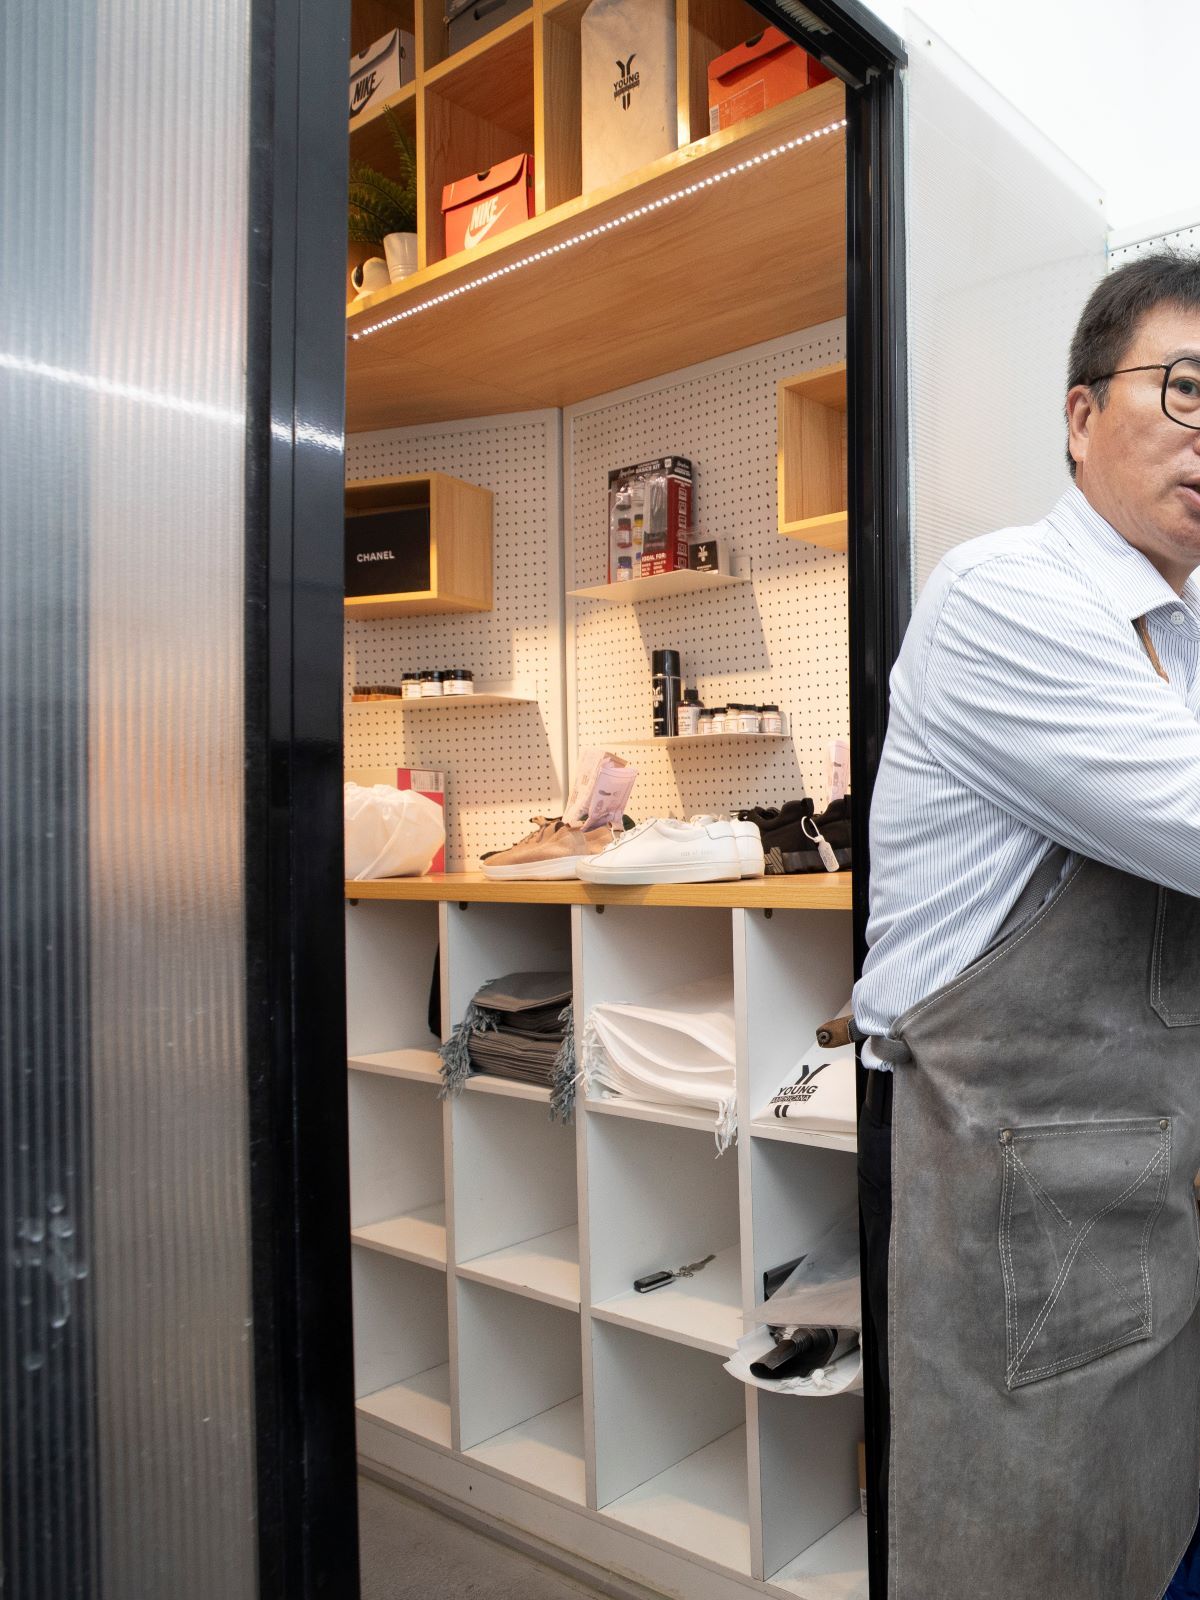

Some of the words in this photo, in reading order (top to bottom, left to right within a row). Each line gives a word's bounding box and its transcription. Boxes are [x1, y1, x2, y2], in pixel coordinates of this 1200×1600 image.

[352, 71, 377, 104] NIKE
[613, 71, 640, 91] YOUNG
[469, 195, 499, 232] NIKE
[356, 550, 396, 563] CHANEL
[777, 1085, 819, 1097] YOUNG
